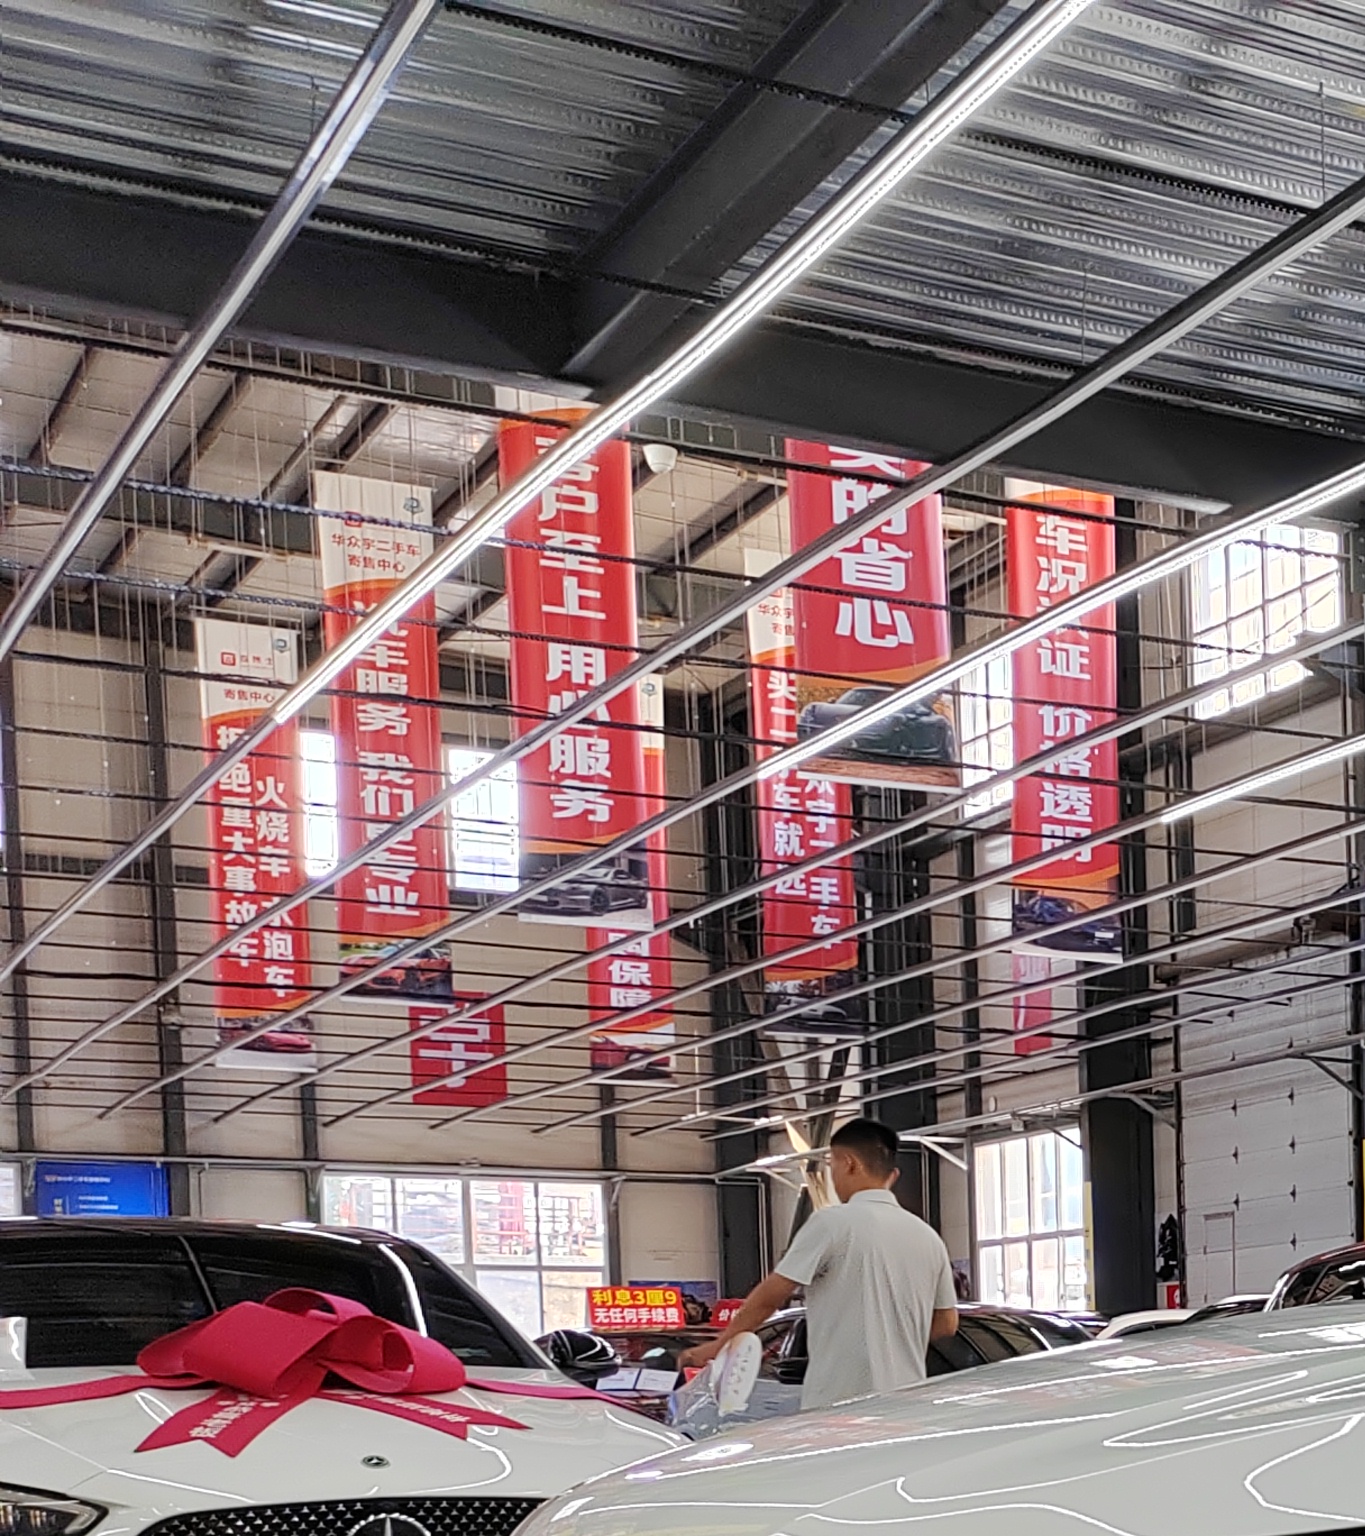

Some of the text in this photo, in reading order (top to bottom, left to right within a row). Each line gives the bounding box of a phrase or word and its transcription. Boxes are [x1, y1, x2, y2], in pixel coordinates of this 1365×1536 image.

[592, 1289, 678, 1307] 利息3厘9
[594, 1307, 680, 1323] 无任何手续费
